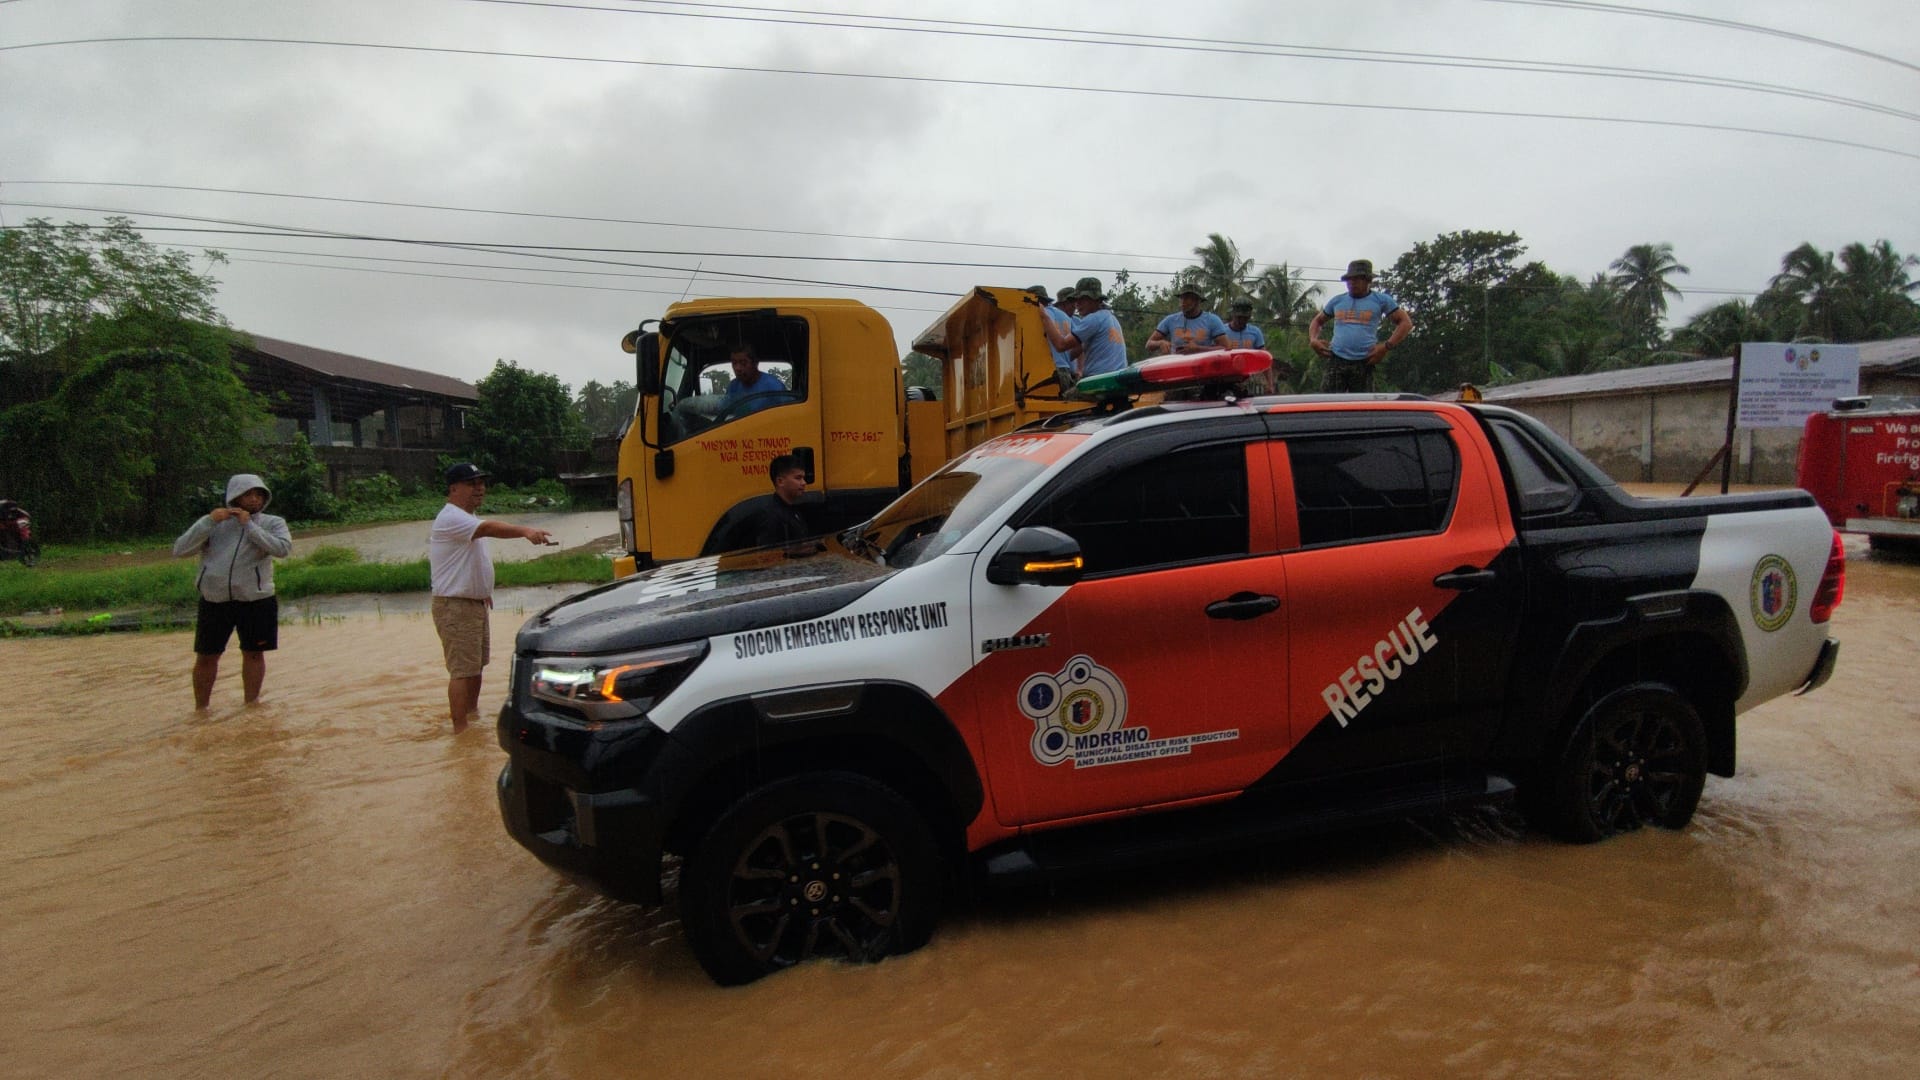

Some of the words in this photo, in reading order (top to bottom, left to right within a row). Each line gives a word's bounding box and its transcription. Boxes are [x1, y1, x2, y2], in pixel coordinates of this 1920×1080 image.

[720, 452, 739, 463] NGA
[734, 628, 783, 659] SIOCON
[784, 615, 856, 651] EMERGENCY
[859, 606, 920, 639] RESPONSE
[920, 601, 949, 630] UNIT
[1321, 606, 1438, 728] RESCUE
[1075, 727, 1148, 749] MDRRMO
[1075, 745, 1122, 758] MUNICIPAL
[1125, 739, 1167, 751] DISASTER
[1169, 738, 1189, 746] RISK
[1191, 730, 1238, 743] REDUCTION
[1076, 758, 1095, 768] AND
[1097, 750, 1157, 764] MANAGEMENT
[1159, 745, 1189, 755] OFFICE
